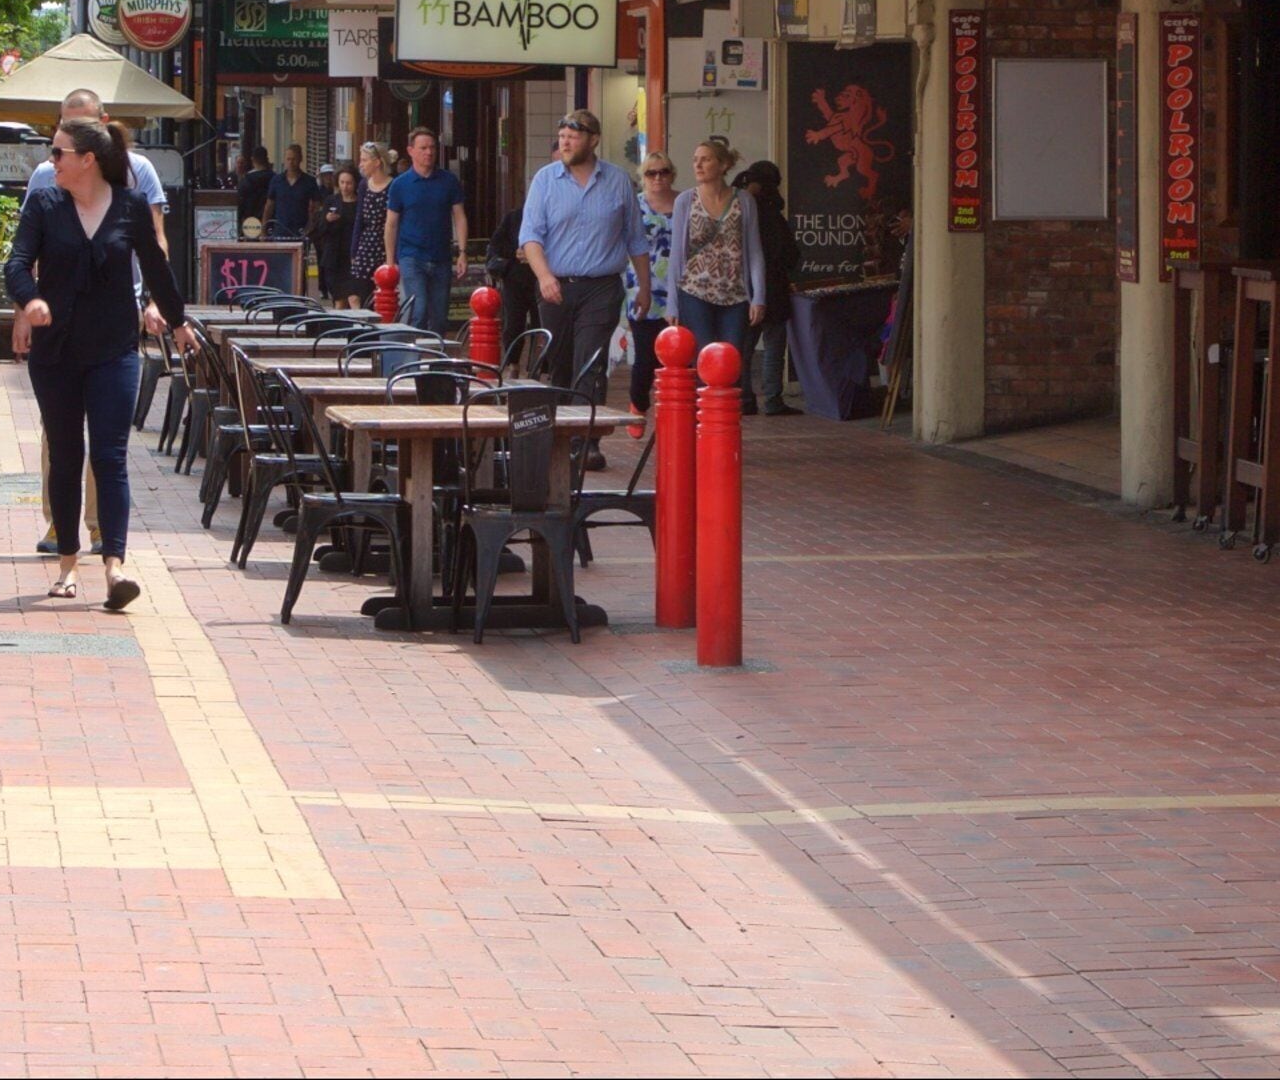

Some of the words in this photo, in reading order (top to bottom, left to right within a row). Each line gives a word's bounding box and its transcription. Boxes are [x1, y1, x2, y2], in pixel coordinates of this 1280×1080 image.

[1164, 18, 1198, 27] cafe
[955, 28, 978, 36] bar
[1167, 34, 1195, 42] bar
[955, 37, 978, 188] POOLROOM
[1167, 44, 1195, 224] POOLROOM
[957, 207, 974, 215] 2nd
[795, 214, 825, 229] THE
[954, 216, 977, 224] Floor
[795, 231, 867, 246] FOUNDA
[801, 261, 834, 272] Here
[839, 260, 859, 273] for
